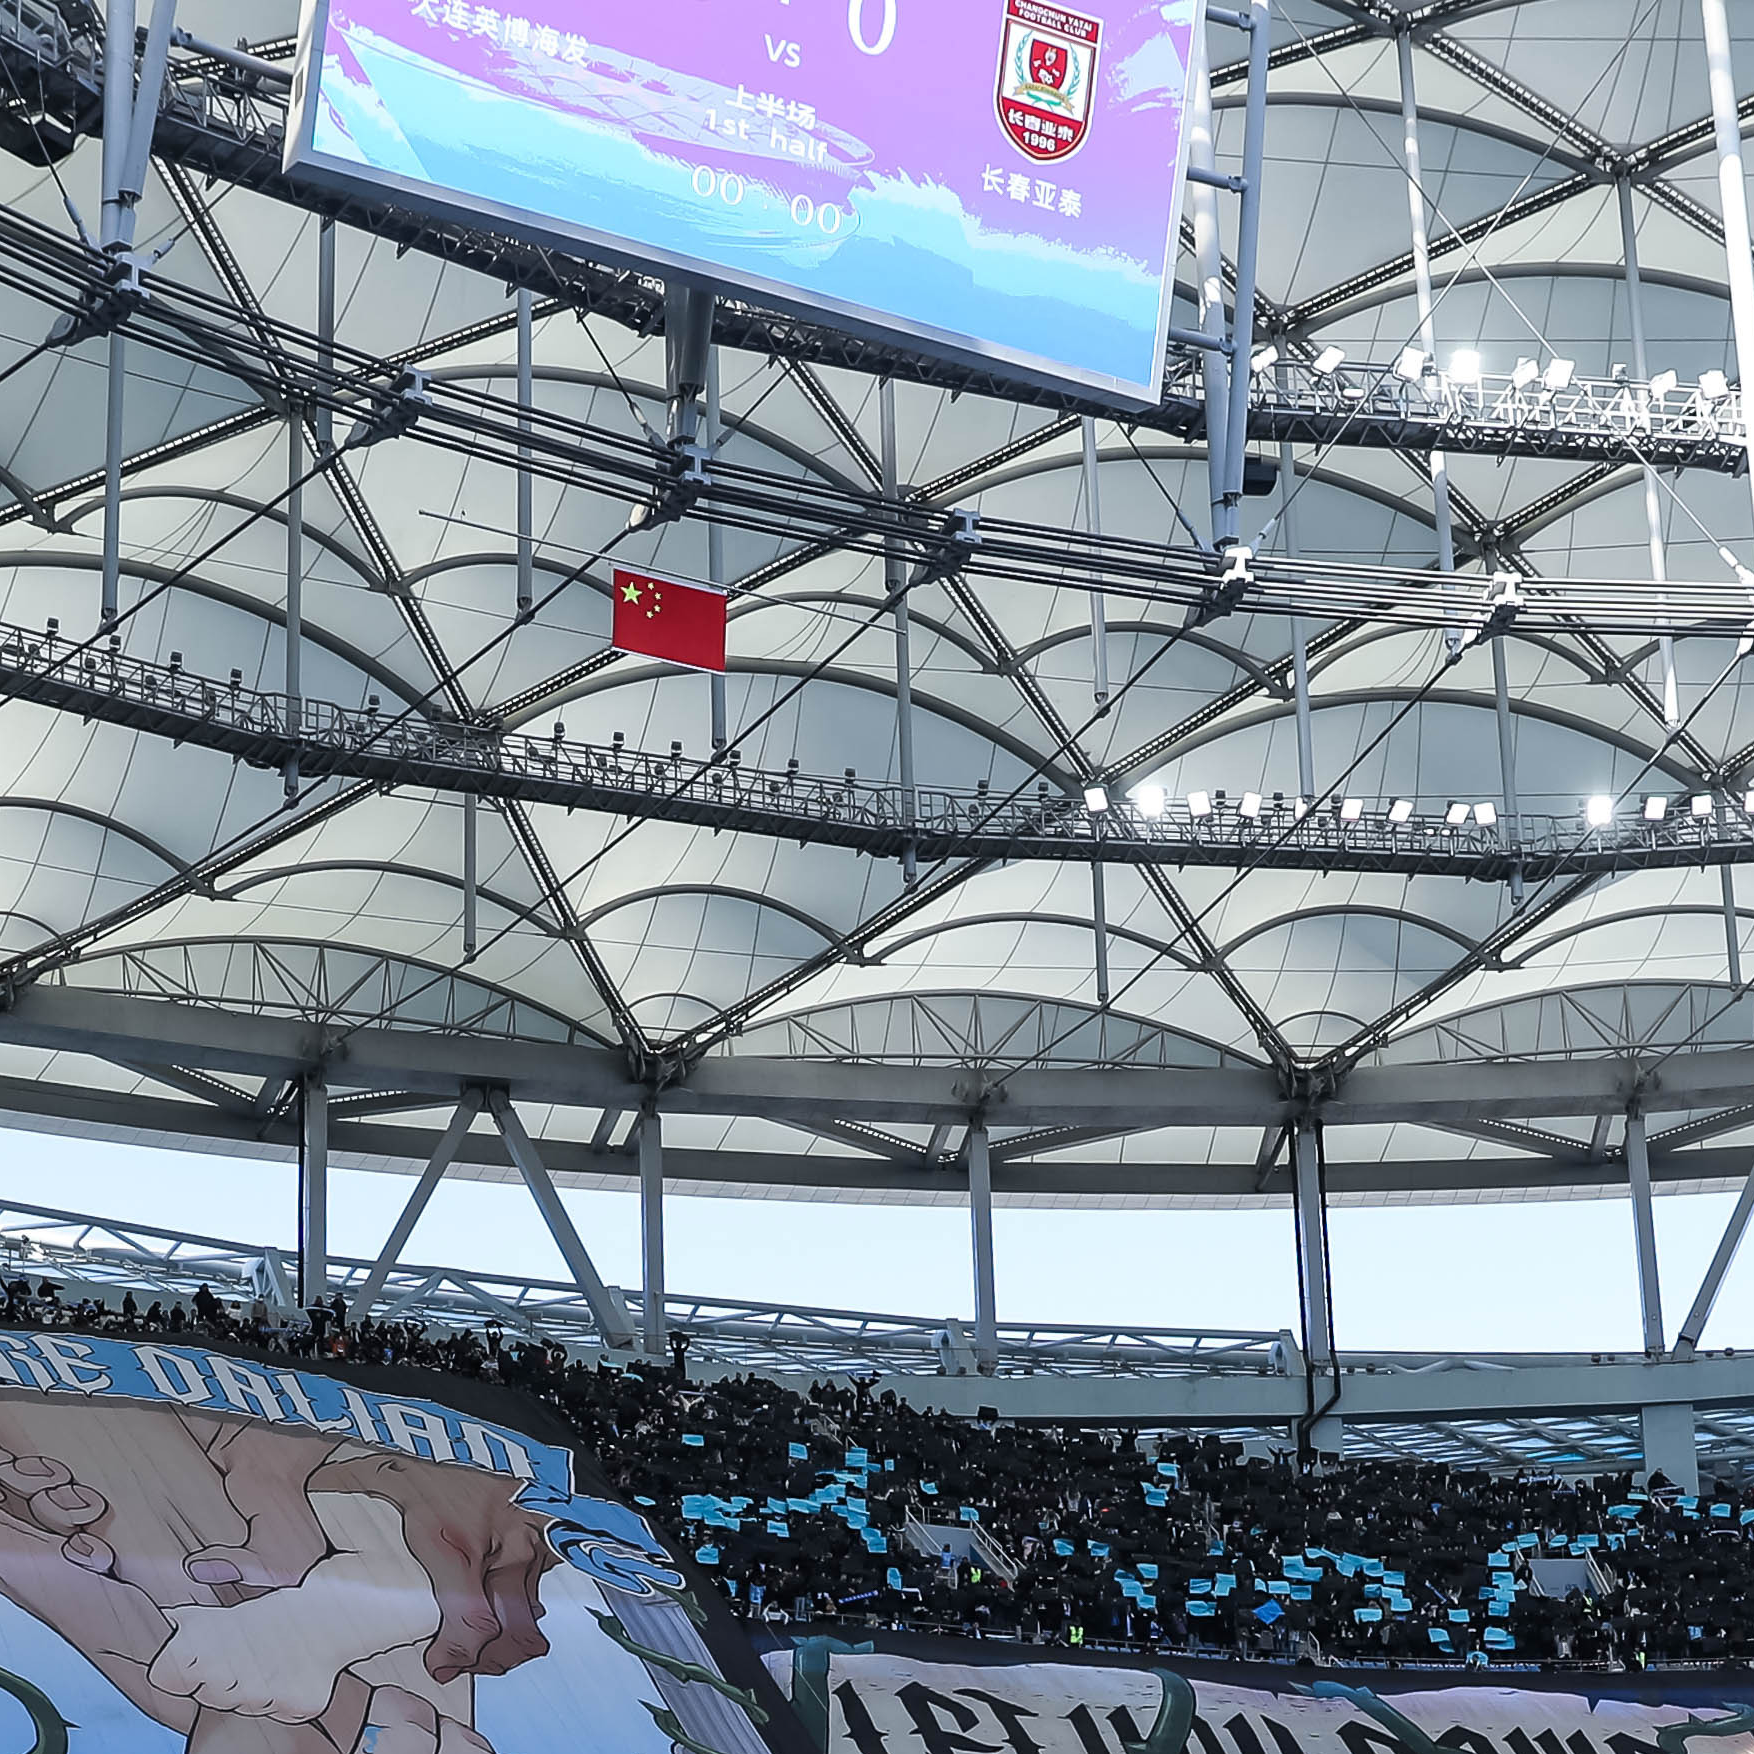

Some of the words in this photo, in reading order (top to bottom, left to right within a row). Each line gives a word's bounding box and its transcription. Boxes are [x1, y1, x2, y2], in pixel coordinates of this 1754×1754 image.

[410, 0, 591, 67] 大连英博海发
[1019, 9, 1062, 29] FOOTBALL
[1064, 23, 1088, 38] CLUB
[1067, 15, 1093, 32] YATAI
[764, 34, 802, 68] VS
[725, 84, 818, 130] 上半场
[704, 109, 749, 141] 1st
[770, 126, 829, 163] half
[1022, 131, 1056, 152] 1996
[981, 163, 1083, 218] 长春亚泰
[134, 1342, 532, 1479] DALIAN
